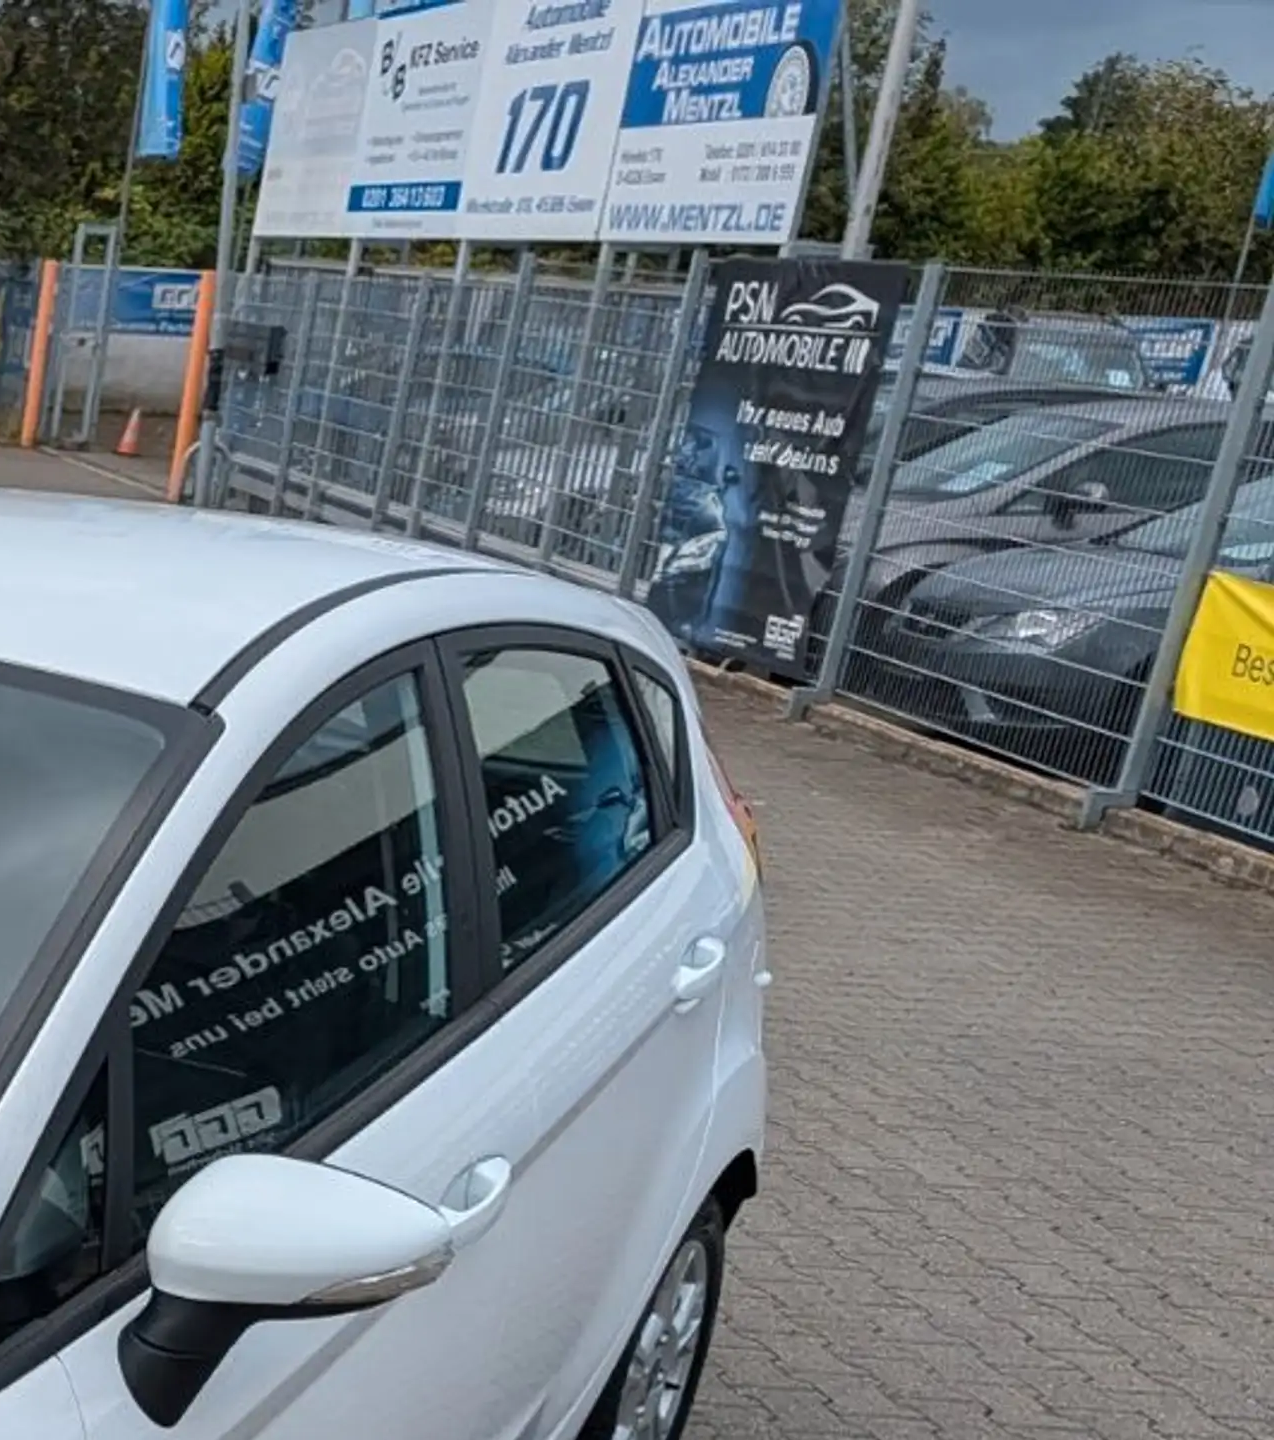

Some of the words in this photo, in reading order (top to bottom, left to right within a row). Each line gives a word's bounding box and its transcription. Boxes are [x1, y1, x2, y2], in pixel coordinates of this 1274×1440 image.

[637, 4, 801, 62] AUTOMOBILE
[410, 42, 433, 69] KFZ
[434, 37, 480, 64] Service
[652, 56, 754, 90] ALEXANDER
[662, 91, 743, 123] MENTZL
[495, 80, 590, 173] 170
[609, 203, 786, 233] WWW.MENTZL.DE
[724, 281, 779, 325] PSN
[715, 331, 844, 371] AUTOMOBILE
